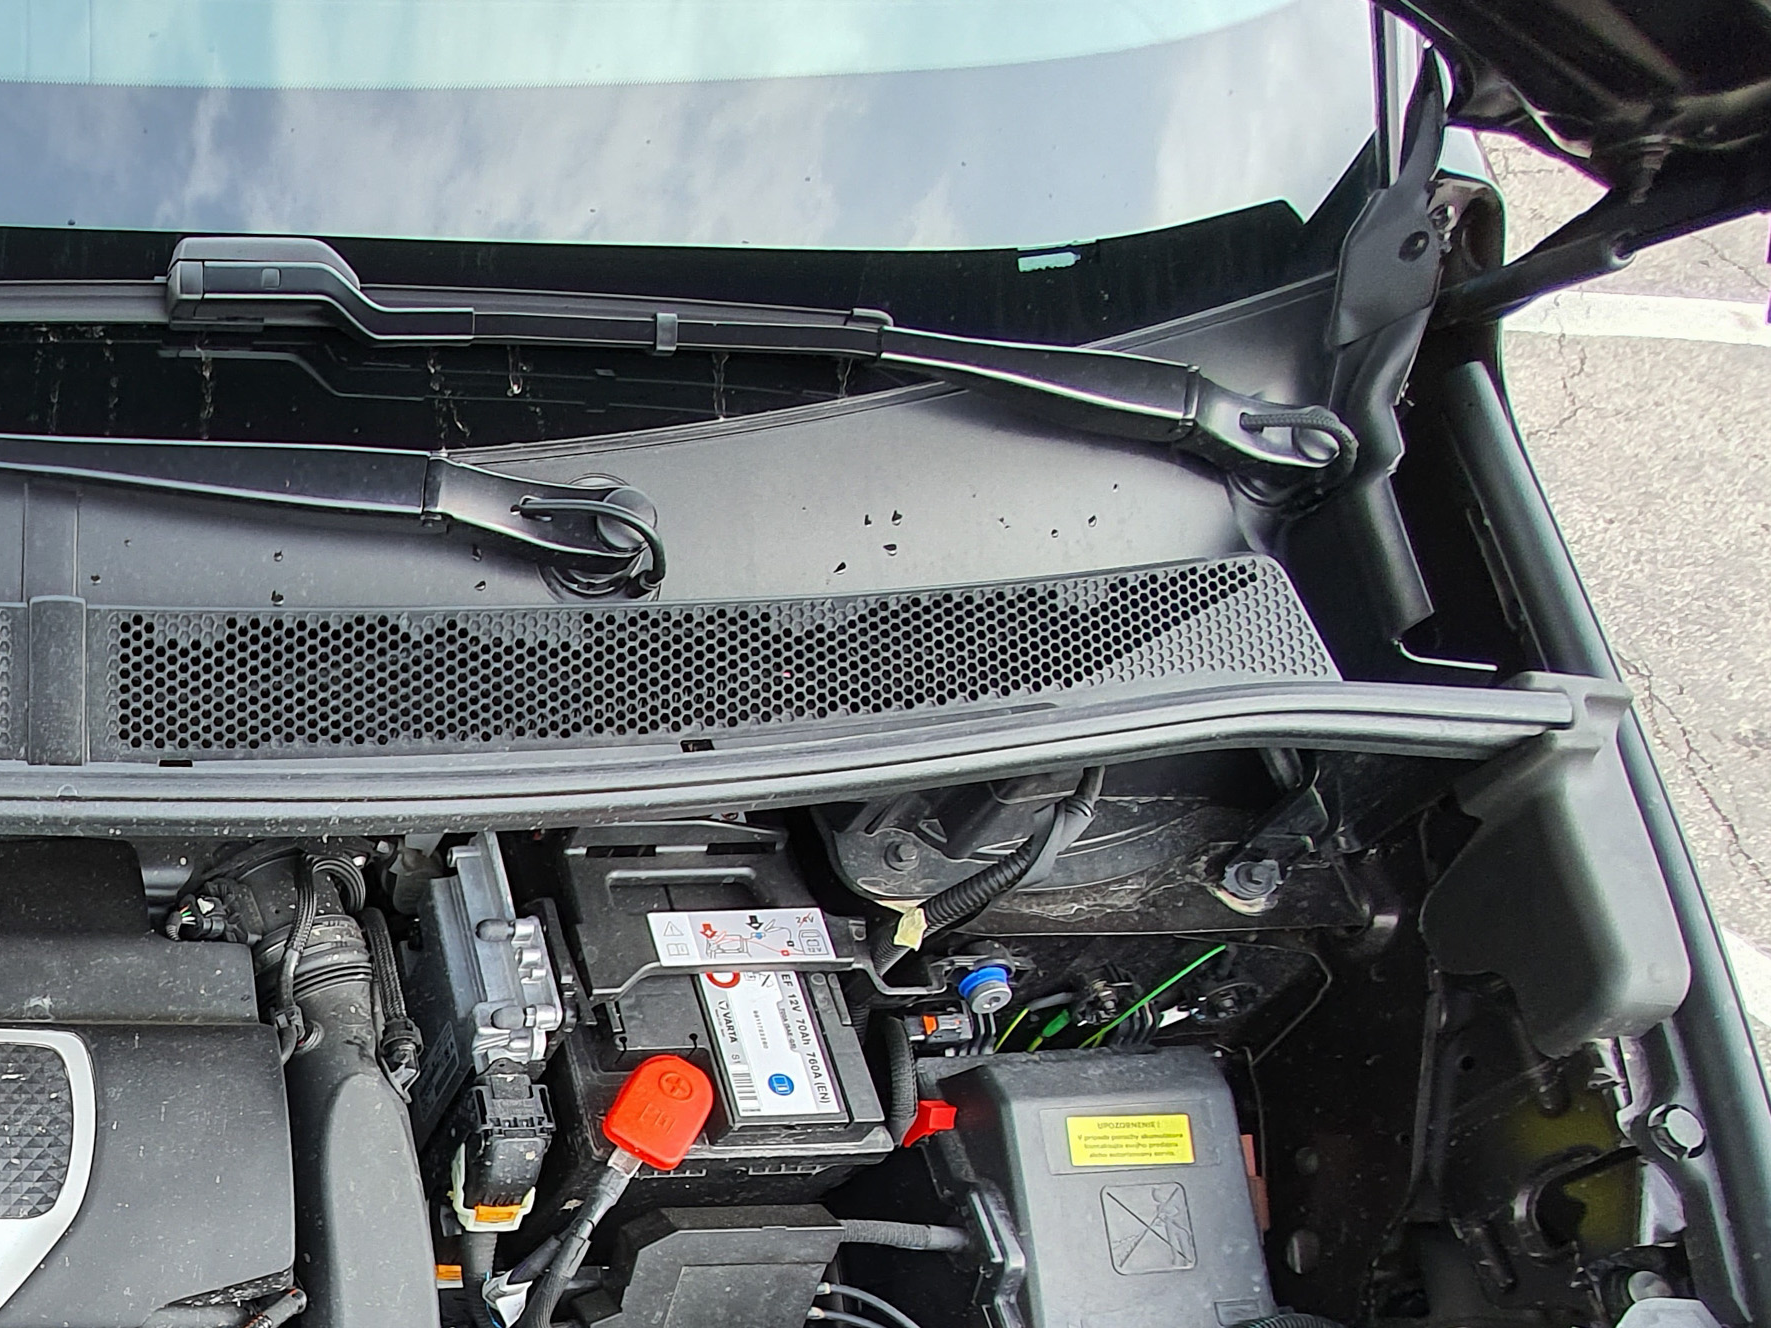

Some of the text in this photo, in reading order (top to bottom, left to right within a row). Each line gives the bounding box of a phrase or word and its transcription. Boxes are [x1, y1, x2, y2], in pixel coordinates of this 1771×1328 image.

[722, 1011, 738, 1043] VARTA
[788, 994, 802, 1012] 12V
[796, 1019, 811, 1046] 70Ah
[806, 1052, 822, 1079] 760A
[814, 1081, 830, 1104] (EN)
